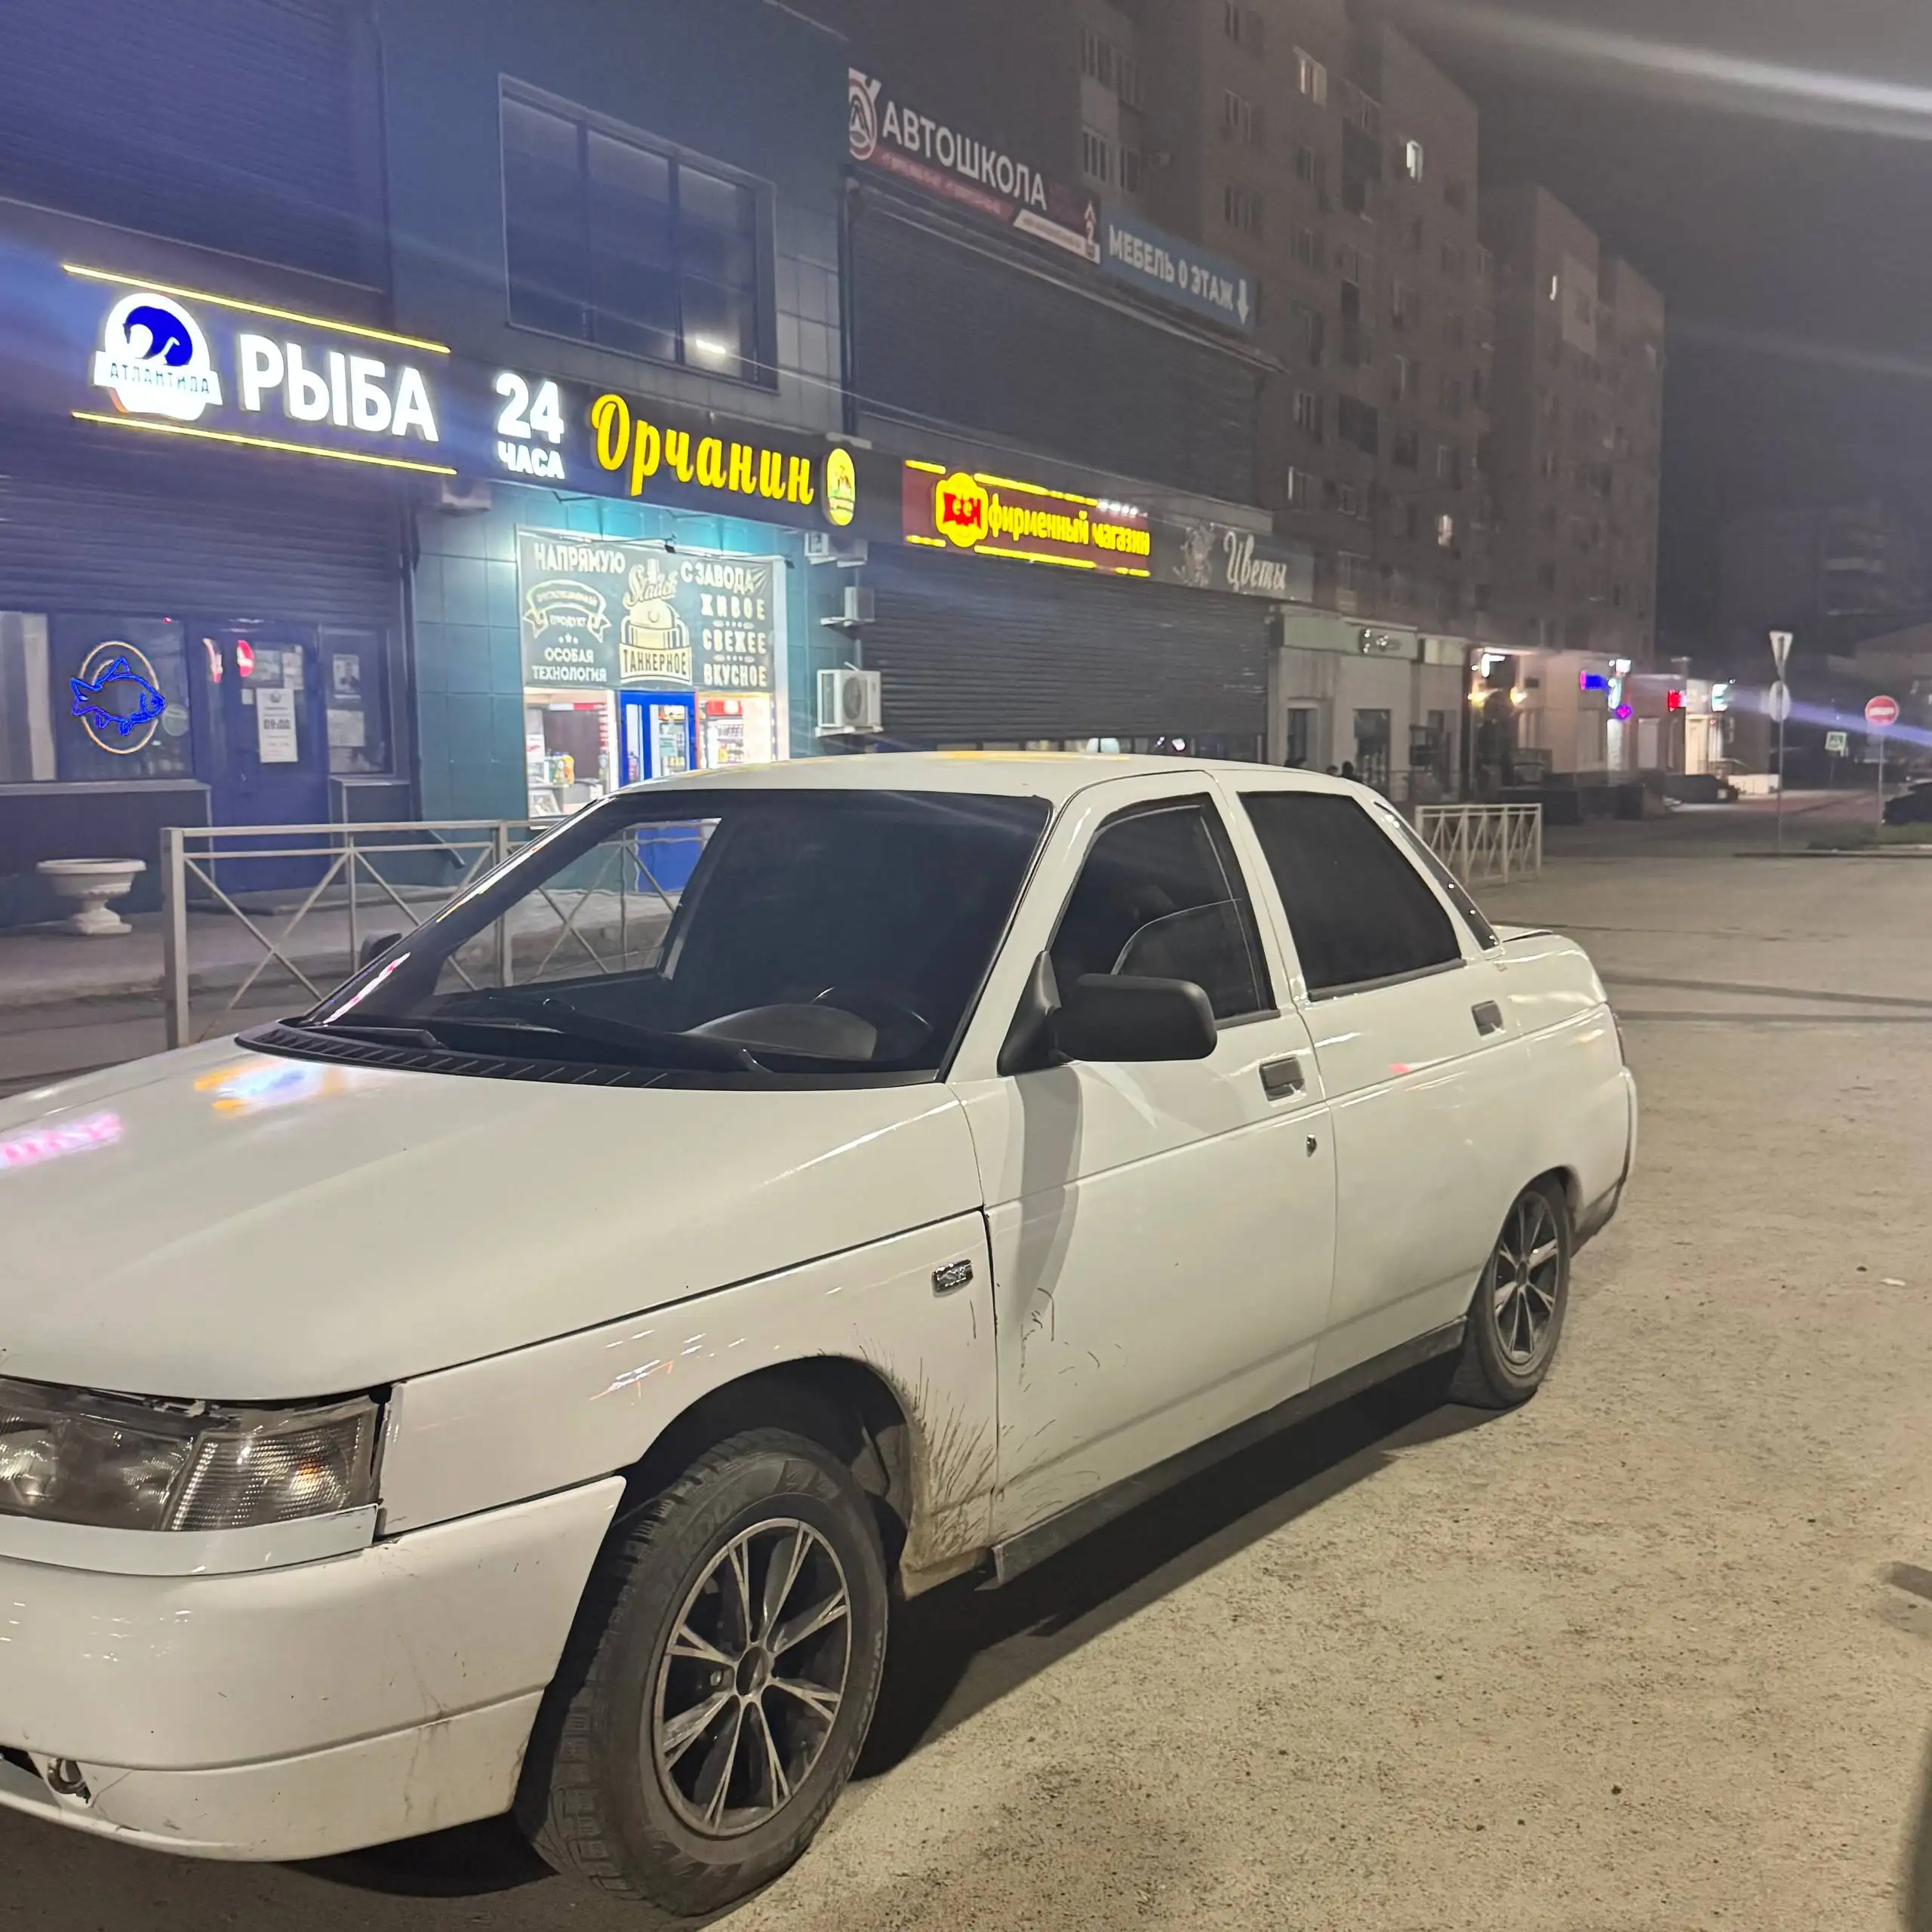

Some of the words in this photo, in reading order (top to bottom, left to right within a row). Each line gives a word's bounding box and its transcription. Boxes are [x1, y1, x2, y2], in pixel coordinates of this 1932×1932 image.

[882, 100, 1048, 211] АВТОШКОЛА
[1109, 224, 1175, 284] МЕБЕЛЬ
[1191, 266, 1235, 312] ЭТАЖ
[238, 334, 439, 442] РЫБА
[495, 373, 565, 444] 24
[497, 440, 566, 480] ЧАСА
[590, 393, 815, 505] Орчанин
[988, 492, 1090, 545] фирменный
[535, 543, 625, 574] НАПРЯМУЮ
[680, 561, 694, 583] С
[695, 566, 756, 595] ЗАВОДА
[1223, 530, 1288, 593] Цветы
[701, 594, 765, 620] ЖИВОЕ
[543, 647, 595, 663] ОСОБАЯ
[622, 648, 688, 675] ТАНКЕРНОЕ
[702, 628, 768, 654] СВЕЖЕЕ
[532, 666, 607, 682] ТЕХНОЛОГИЯ
[703, 663, 768, 688] ВКУСНОЕ
